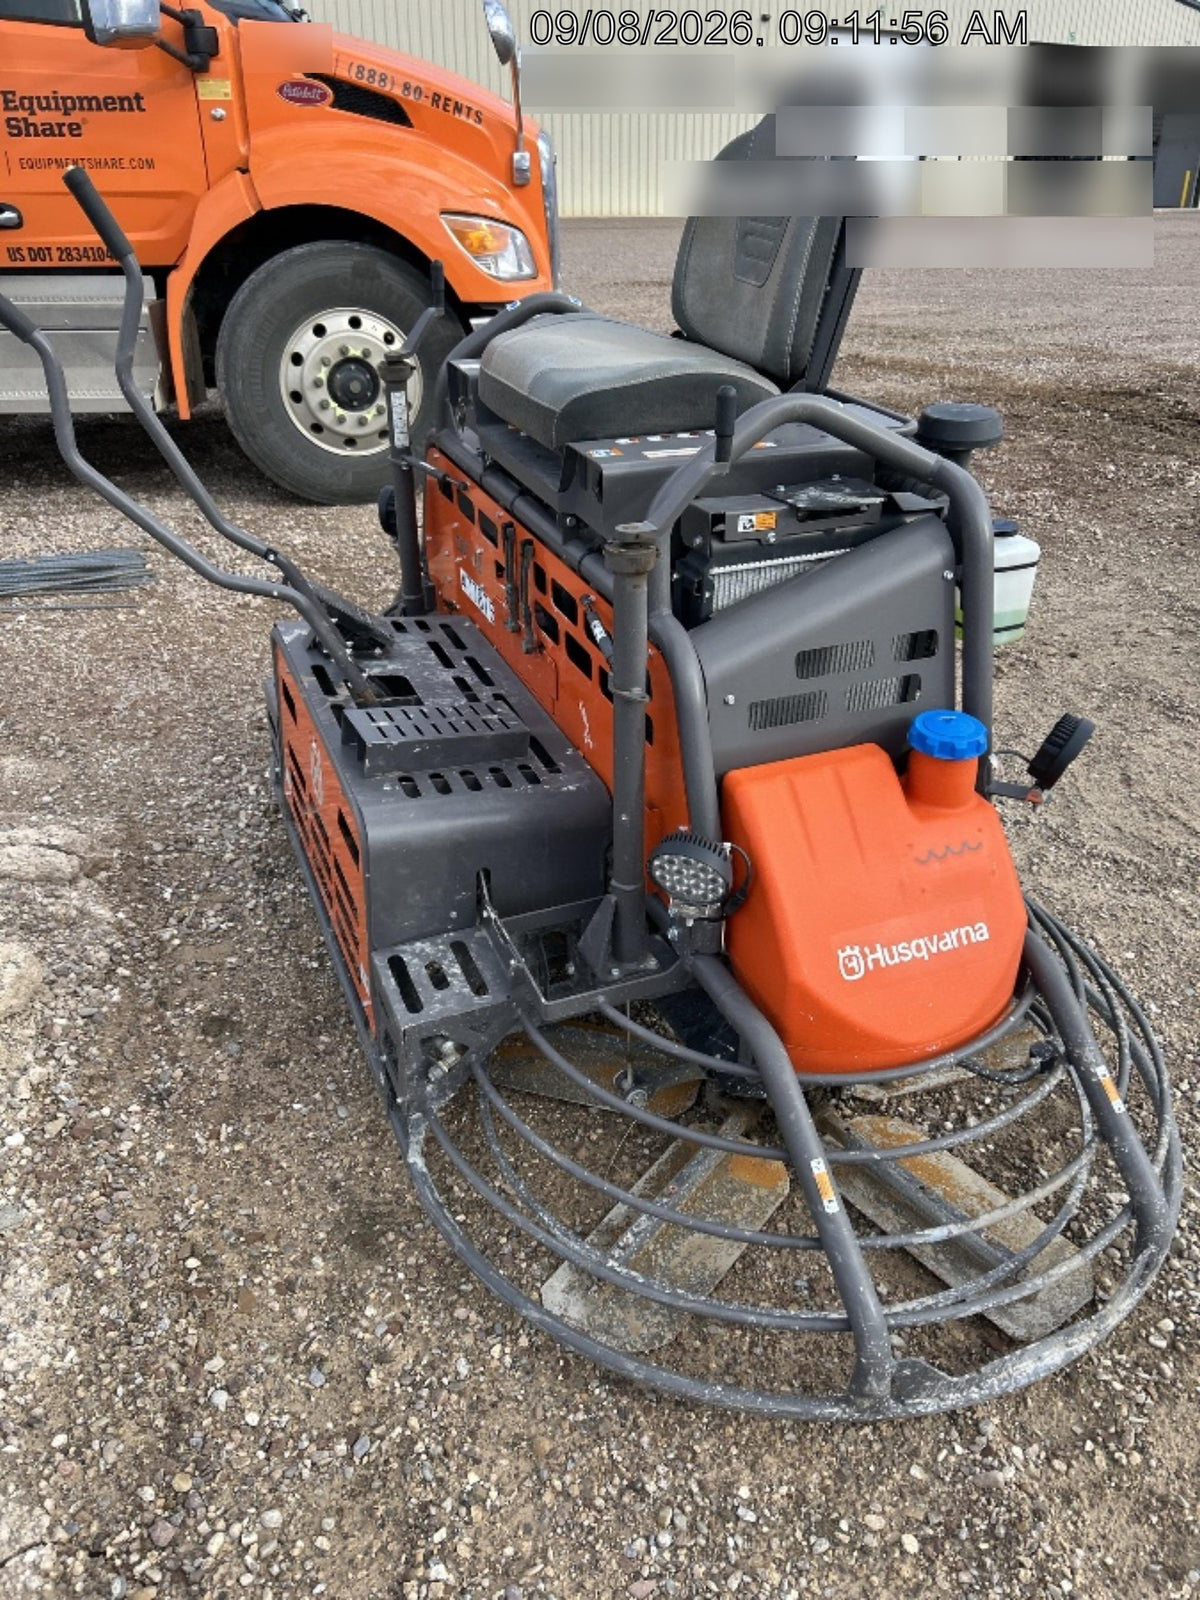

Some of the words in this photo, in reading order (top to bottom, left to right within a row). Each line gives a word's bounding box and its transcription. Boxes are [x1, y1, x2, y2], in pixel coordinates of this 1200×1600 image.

[1, 90, 146, 116] Equipment
[348, 61, 396, 92] (888)
[401, 80, 484, 125] 80-RENTS
[6, 117, 82, 137] Share
[18, 157, 155, 170] EQUIPMENTSHARE.COM
[7, 246, 25, 262] US
[28, 246, 54, 262] DOT
[864, 921, 989, 971] Husqvarna
